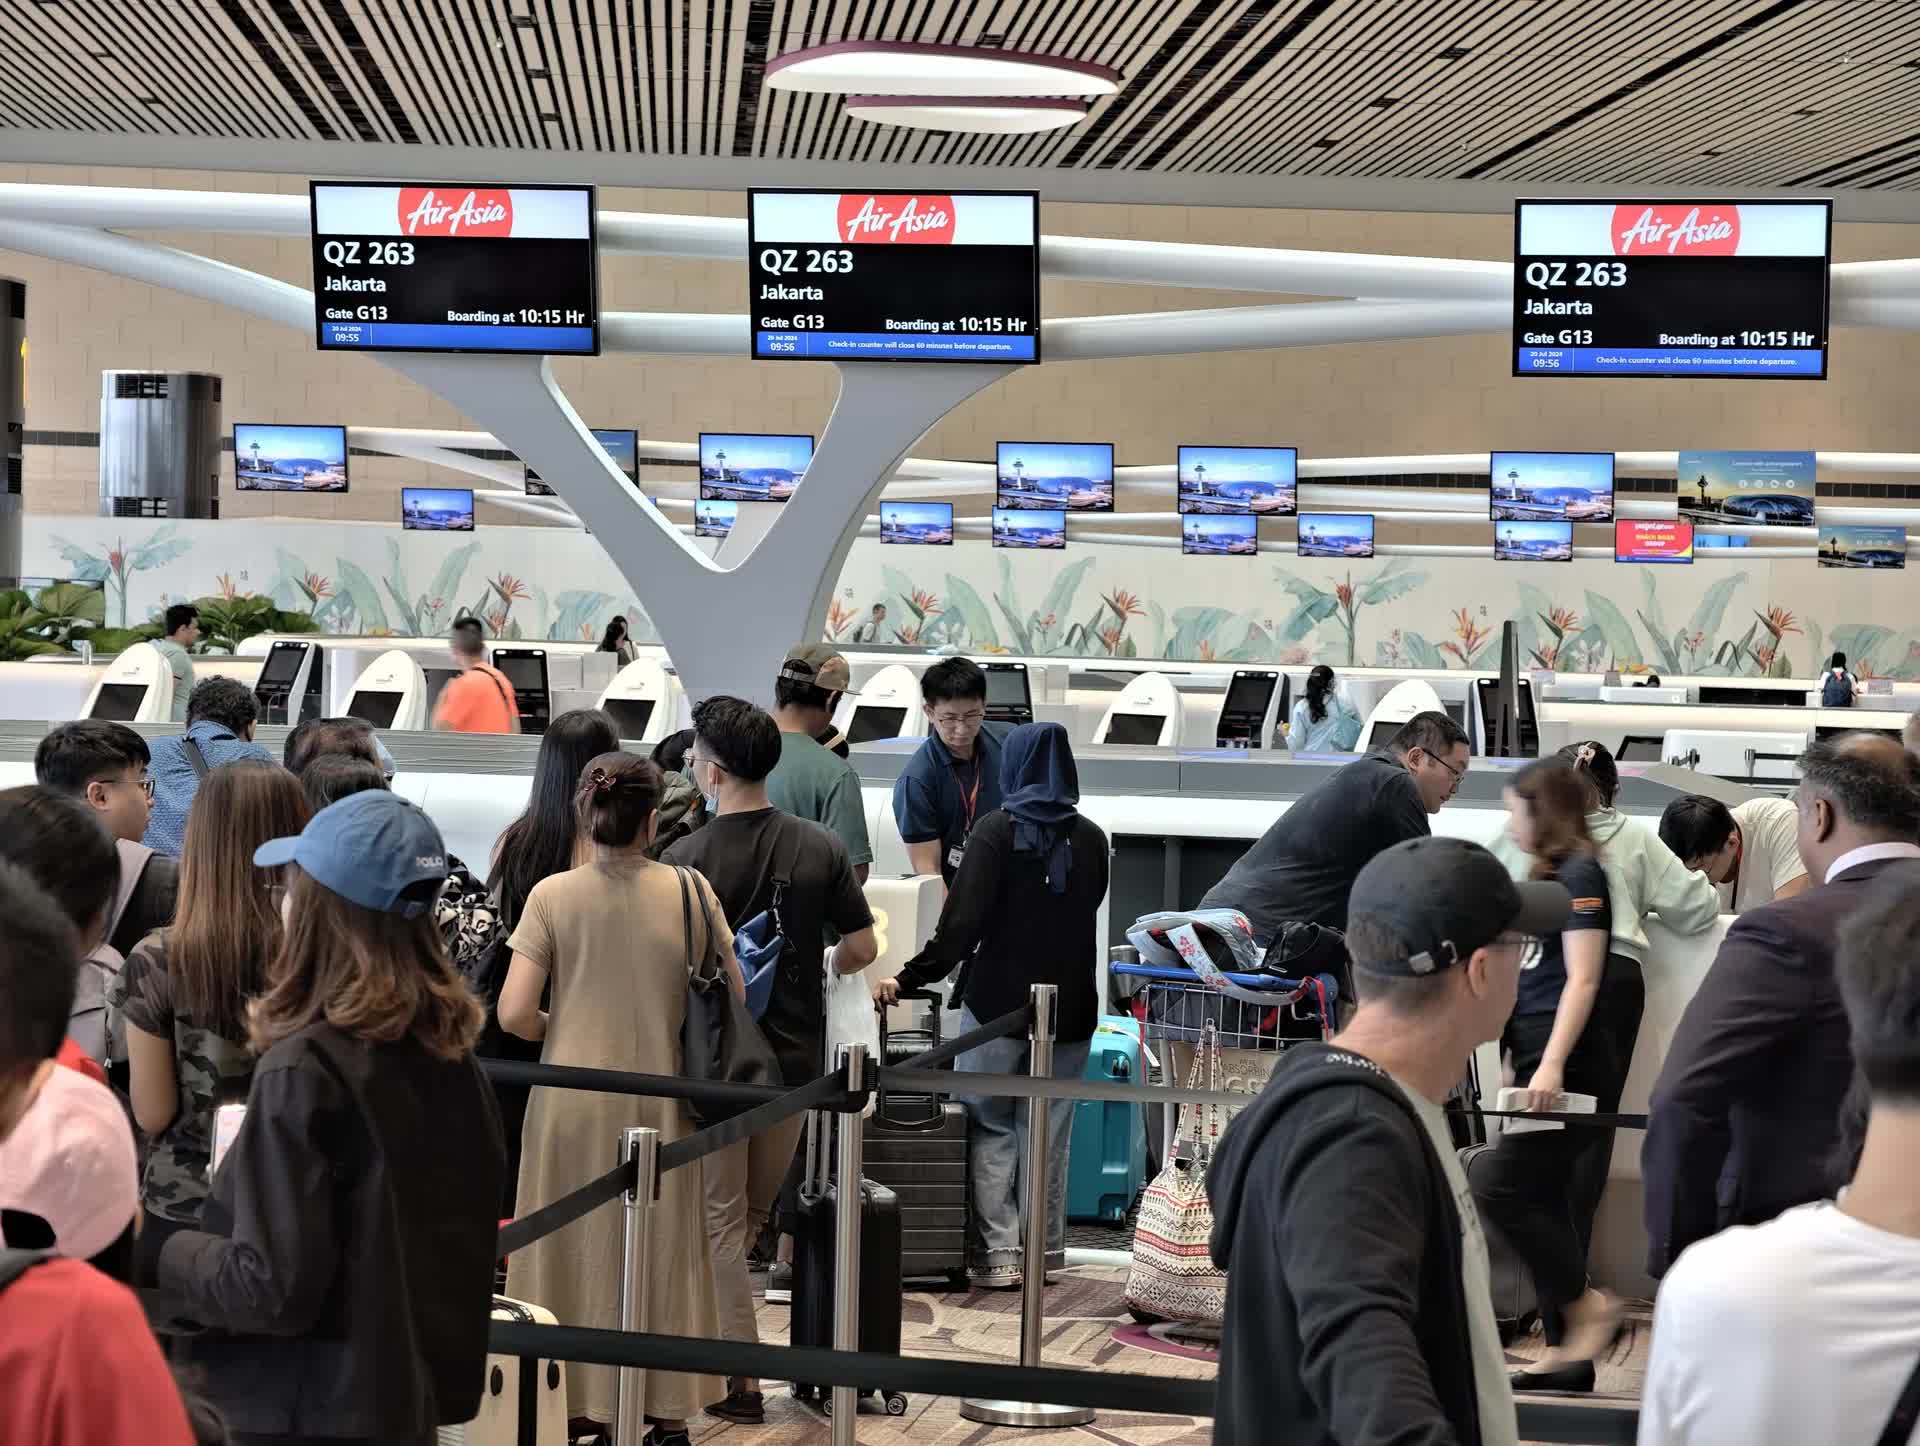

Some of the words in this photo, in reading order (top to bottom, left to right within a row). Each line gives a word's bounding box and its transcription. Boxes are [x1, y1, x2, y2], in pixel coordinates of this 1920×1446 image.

[323, 240, 362, 268] QZ
[368, 241, 415, 266] 263
[760, 248, 799, 276] QZ
[806, 249, 854, 274] 263
[323, 274, 387, 293] Jakarta
[1525, 262, 1567, 290] QZ
[1575, 262, 1627, 287] 263
[759, 283, 824, 301] Jakarta
[325, 307, 354, 320] Gate
[356, 305, 388, 321] G13
[1523, 297, 1593, 315] Jakarta
[447, 310, 500, 325] Boarding
[502, 312, 516, 323] at
[518, 308, 561, 324] 10:15
[565, 309, 585, 325] Hr
[760, 316, 790, 329] Gate
[792, 314, 825, 329] G13
[885, 318, 940, 334] Boarding
[942, 320, 956, 331] at
[959, 316, 1003, 332] 10:15
[1007, 317, 1028, 332] Hr
[334, 332, 360, 343] 09:55
[1523, 332, 1555, 344] Gate
[1558, 329, 1593, 345] G13
[1659, 333, 1719, 348] Boarding
[1720, 334, 1736, 346] at
[1740, 330, 1788, 347] 10:15
[1792, 331, 1815, 347] Hr
[770, 342, 795, 352] 09:56
[828, 340, 856, 348] Check-in
[885, 341, 897, 349] will
[898, 341, 915, 349] close
[926, 342, 953, 350] minutes
[954, 342, 976, 350] before
[977, 343, 1012, 352] departure.
[1532, 358, 1560, 368] 09:56
[1596, 356, 1627, 364] Check-in
[1658, 356, 1671, 364] will
[1673, 356, 1691, 365] close
[1703, 357, 1732, 365] minutes
[1734, 357, 1758, 365] before
[1759, 357, 1796, 367] departure.
